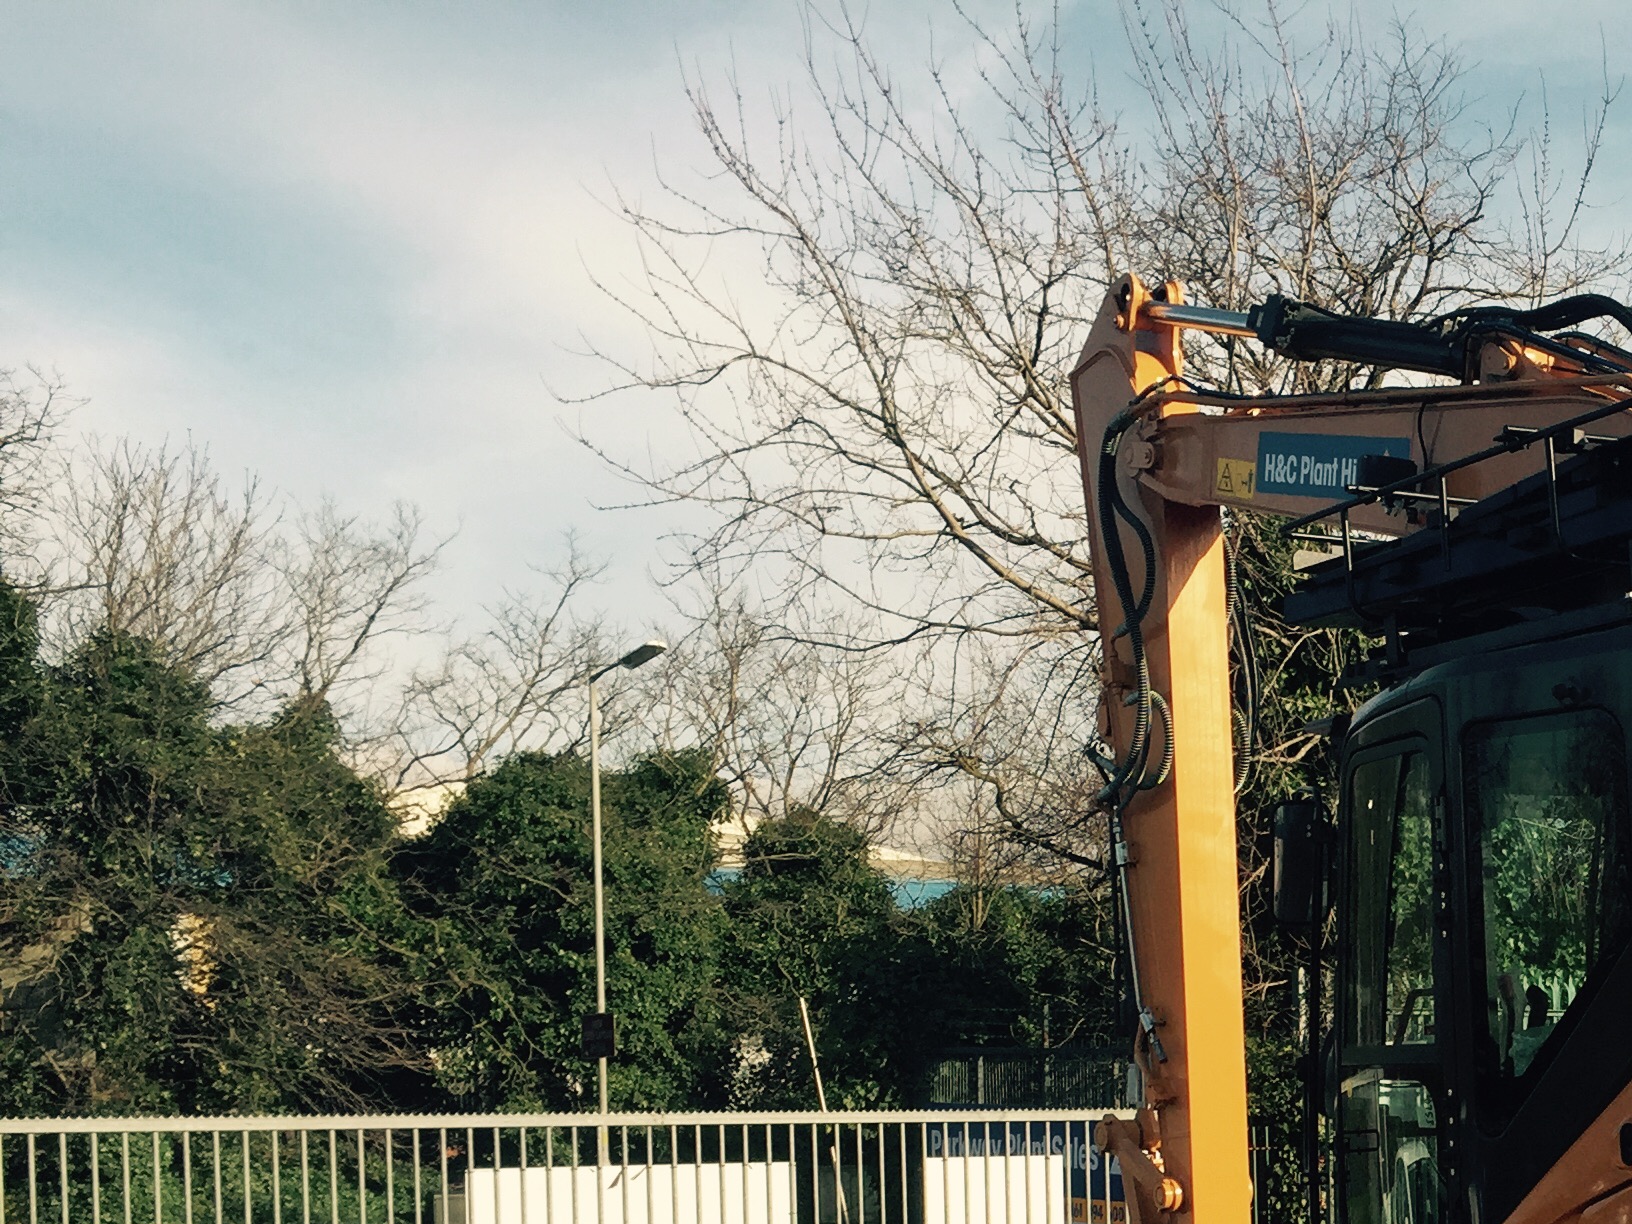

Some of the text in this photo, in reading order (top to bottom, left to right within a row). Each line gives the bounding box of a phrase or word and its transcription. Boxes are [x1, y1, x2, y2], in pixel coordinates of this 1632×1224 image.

[1265, 453, 1357, 487] H&C Plant Hi
